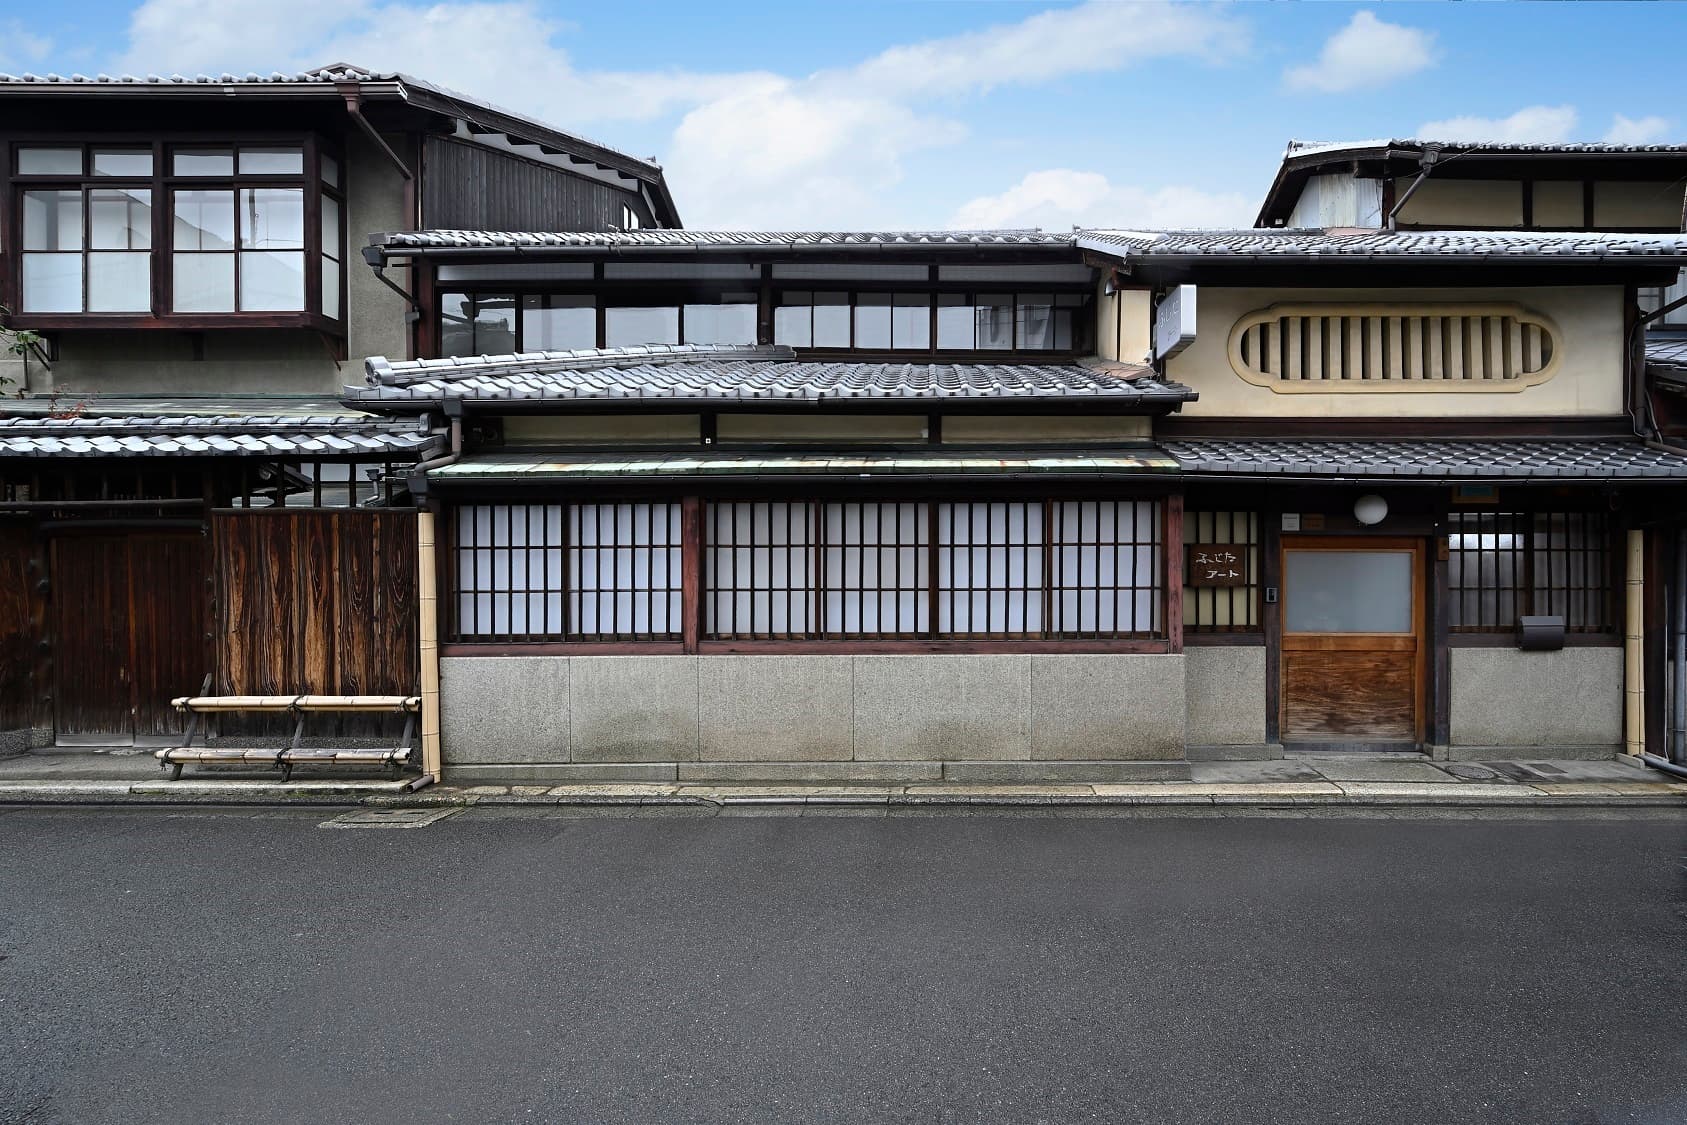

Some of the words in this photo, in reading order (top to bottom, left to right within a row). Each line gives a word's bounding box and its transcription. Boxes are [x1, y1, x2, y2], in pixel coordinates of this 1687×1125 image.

[1195, 551, 1237, 564] ふじた
[1205, 569, 1239, 579] アート
